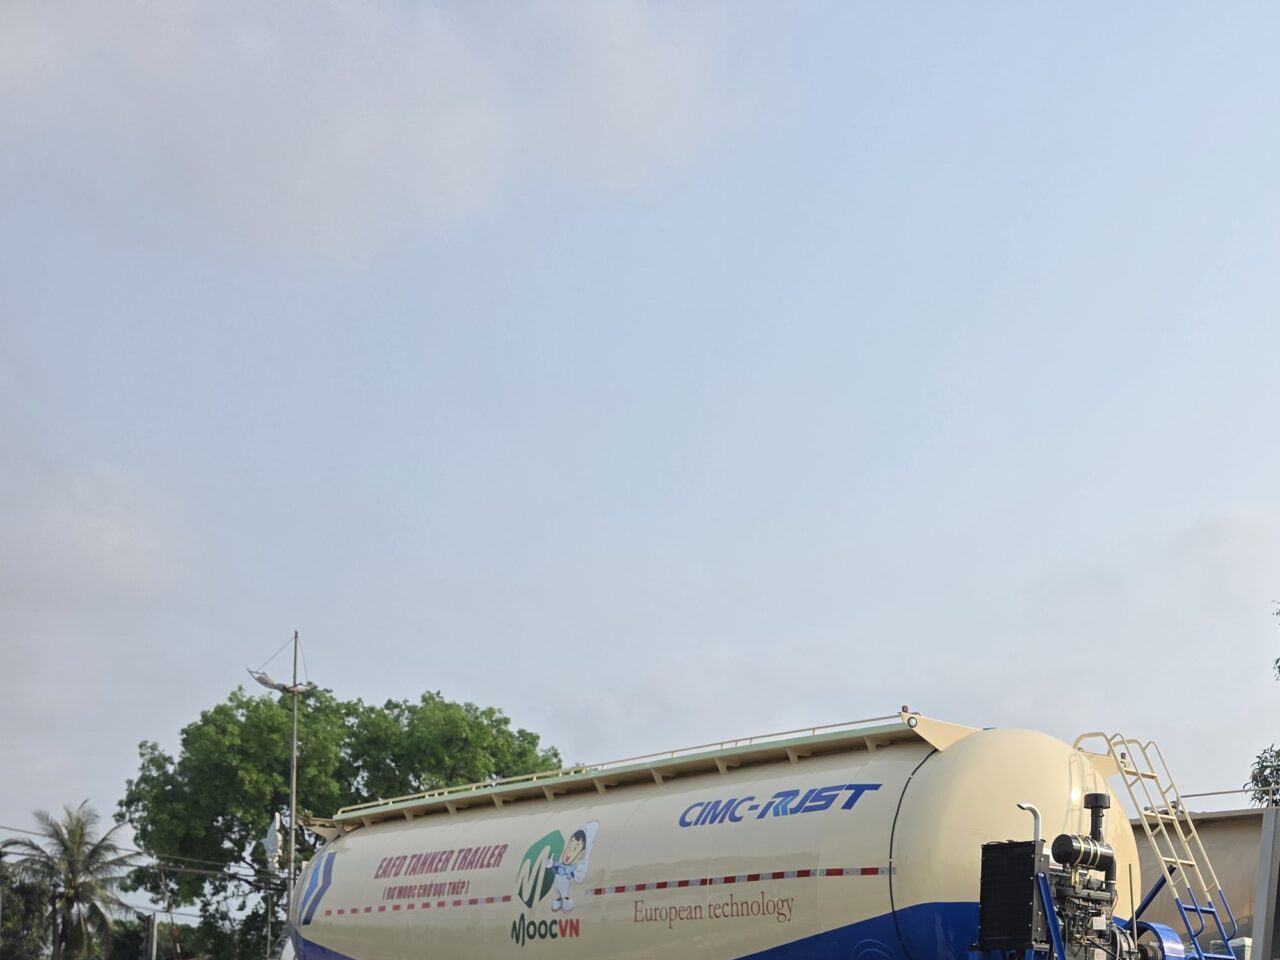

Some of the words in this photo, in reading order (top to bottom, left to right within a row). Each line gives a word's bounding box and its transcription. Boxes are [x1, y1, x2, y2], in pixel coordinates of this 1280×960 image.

[374, 855, 408, 880] EAFD
[404, 849, 455, 877] TANKER
[451, 843, 509, 872] TRAILER
[633, 899, 703, 929] European
[708, 891, 795, 924] technology
